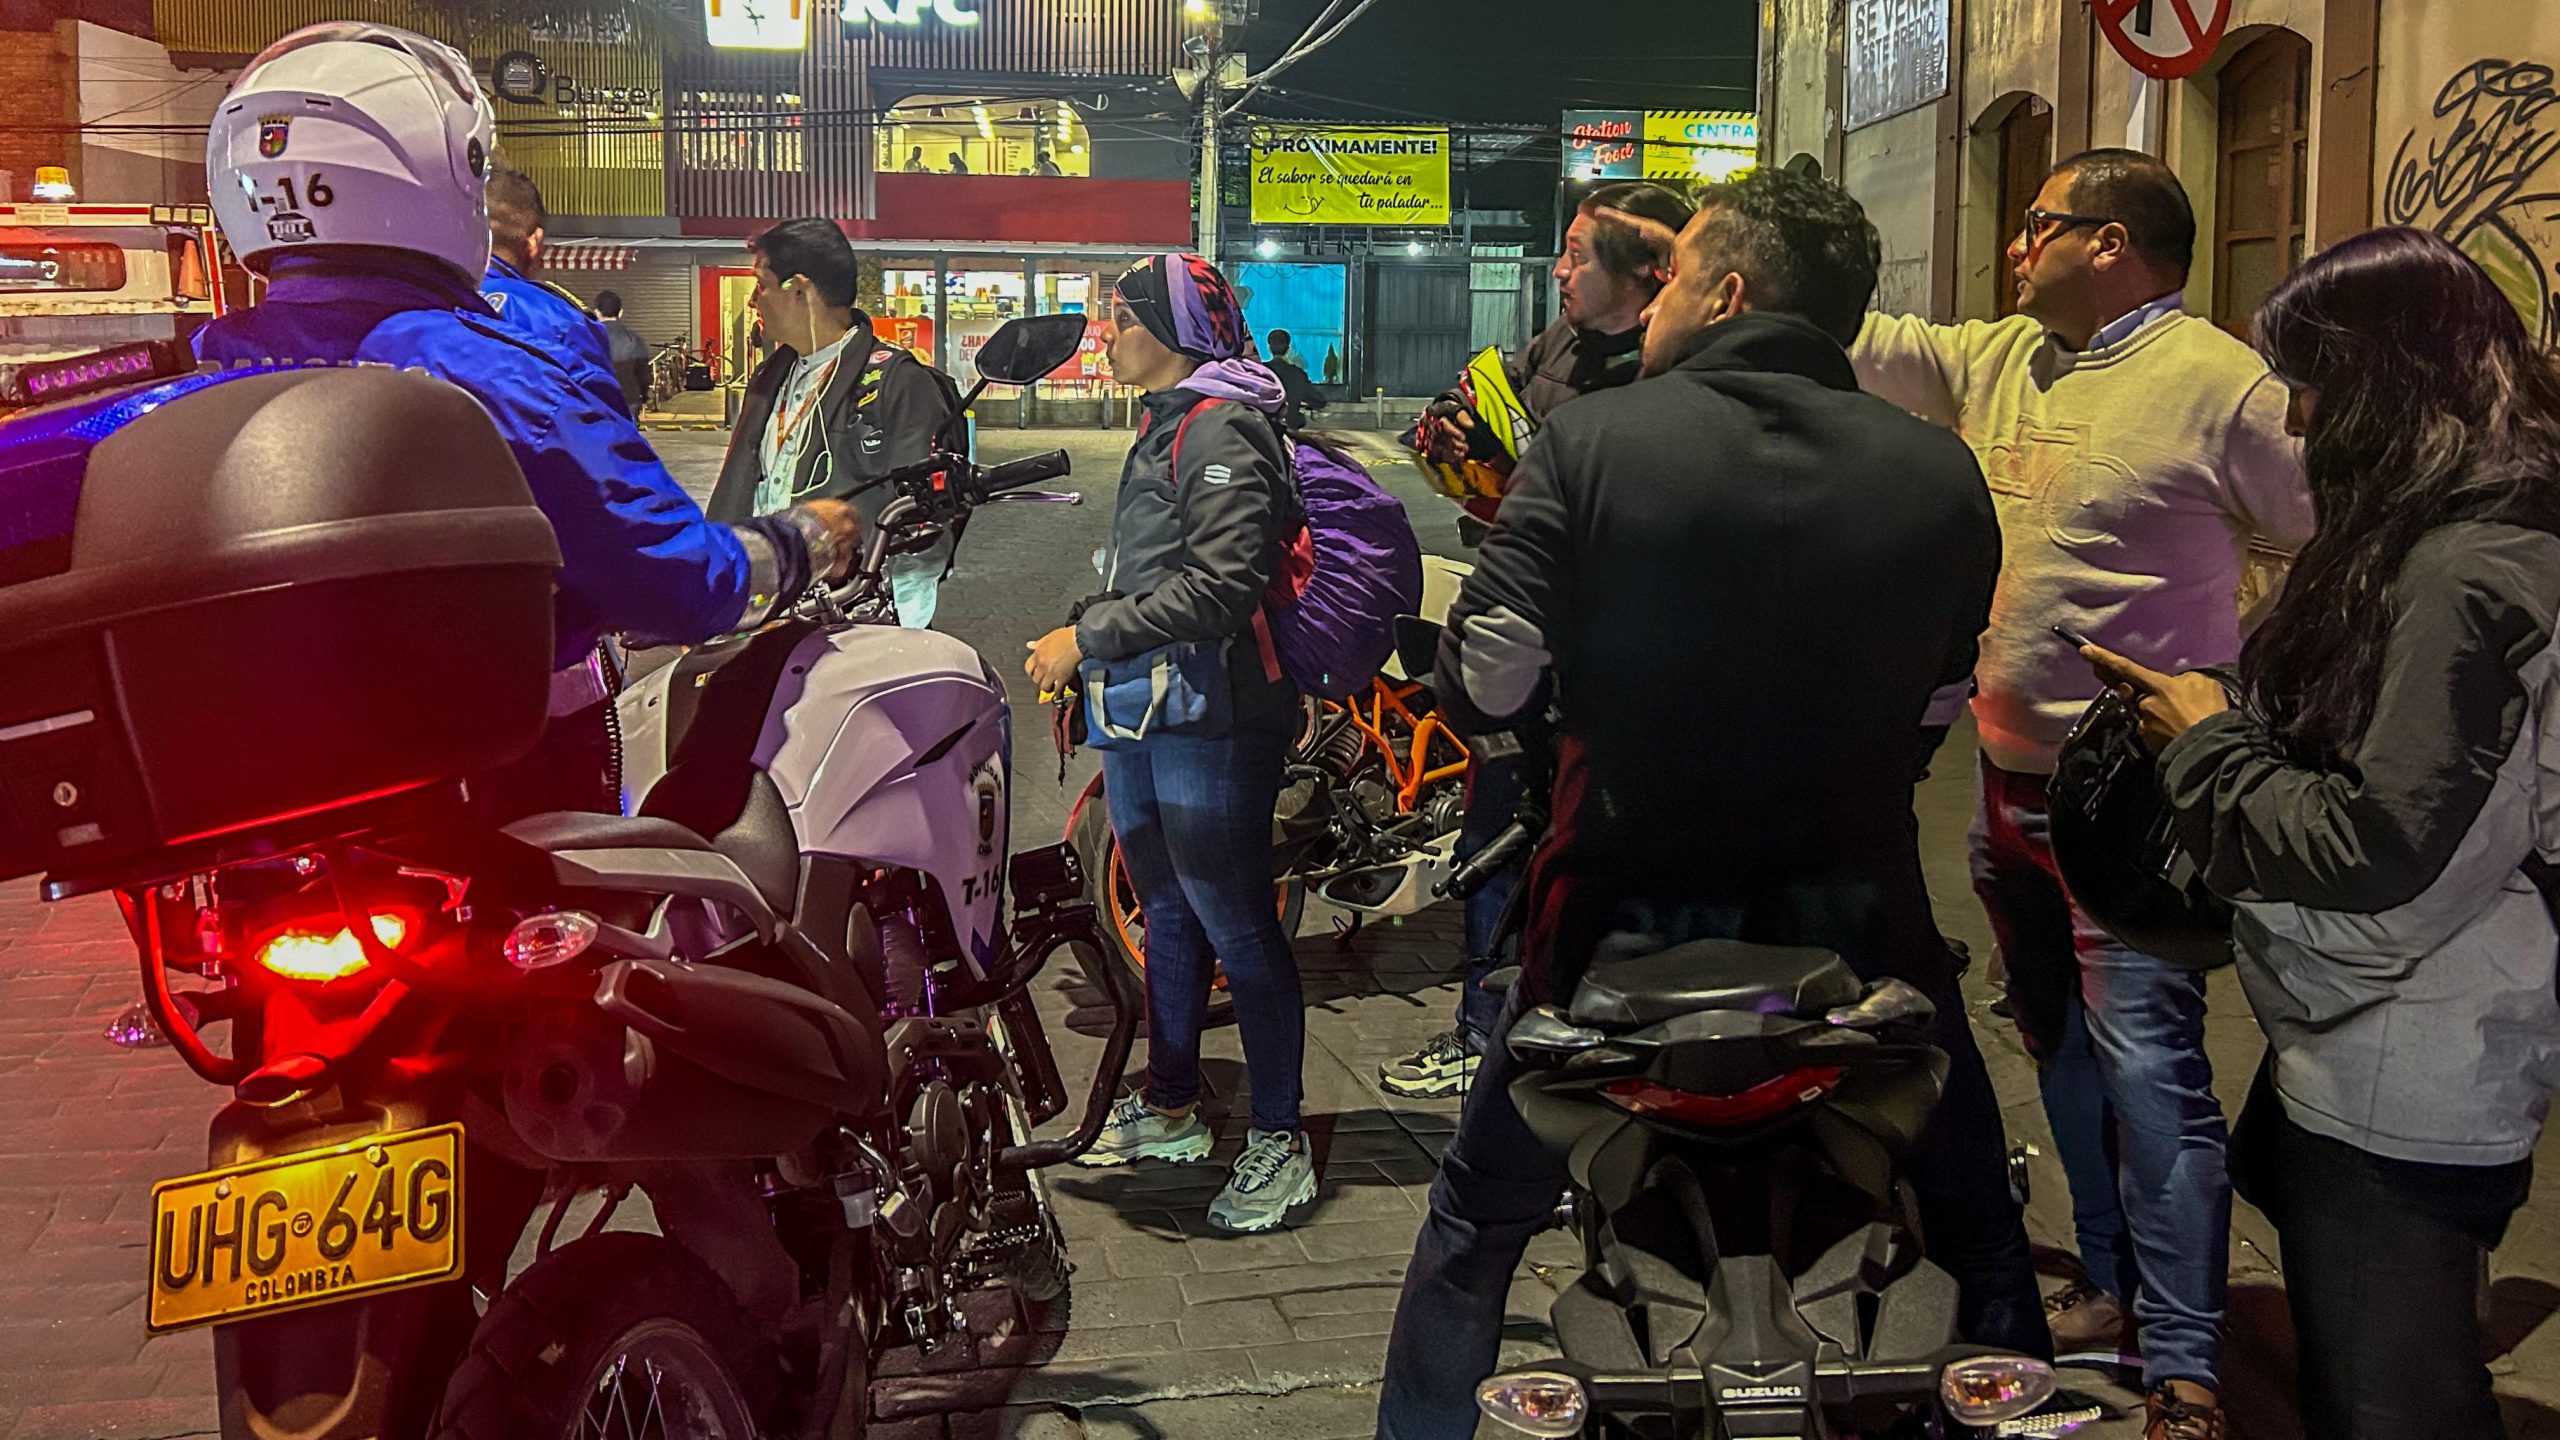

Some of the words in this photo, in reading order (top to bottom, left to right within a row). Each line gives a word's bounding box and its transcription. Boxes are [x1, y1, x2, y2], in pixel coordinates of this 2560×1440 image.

[1591, 142, 1634, 170] Food
[1258, 167, 1273, 184] El
[1277, 167, 1316, 184] sabor
[1320, 172, 1334, 184] se
[1337, 170, 1393, 188] quedará
[1396, 173, 1413, 185] en
[1377, 191, 1443, 211] paladar...
[961, 864, 1000, 906] T-16
[159, 1189, 288, 1291] UHG
[316, 1158, 451, 1262] 64G
[245, 1263, 356, 1305] COLOMBIA
[1722, 1386, 1801, 1399] SUZUKI
